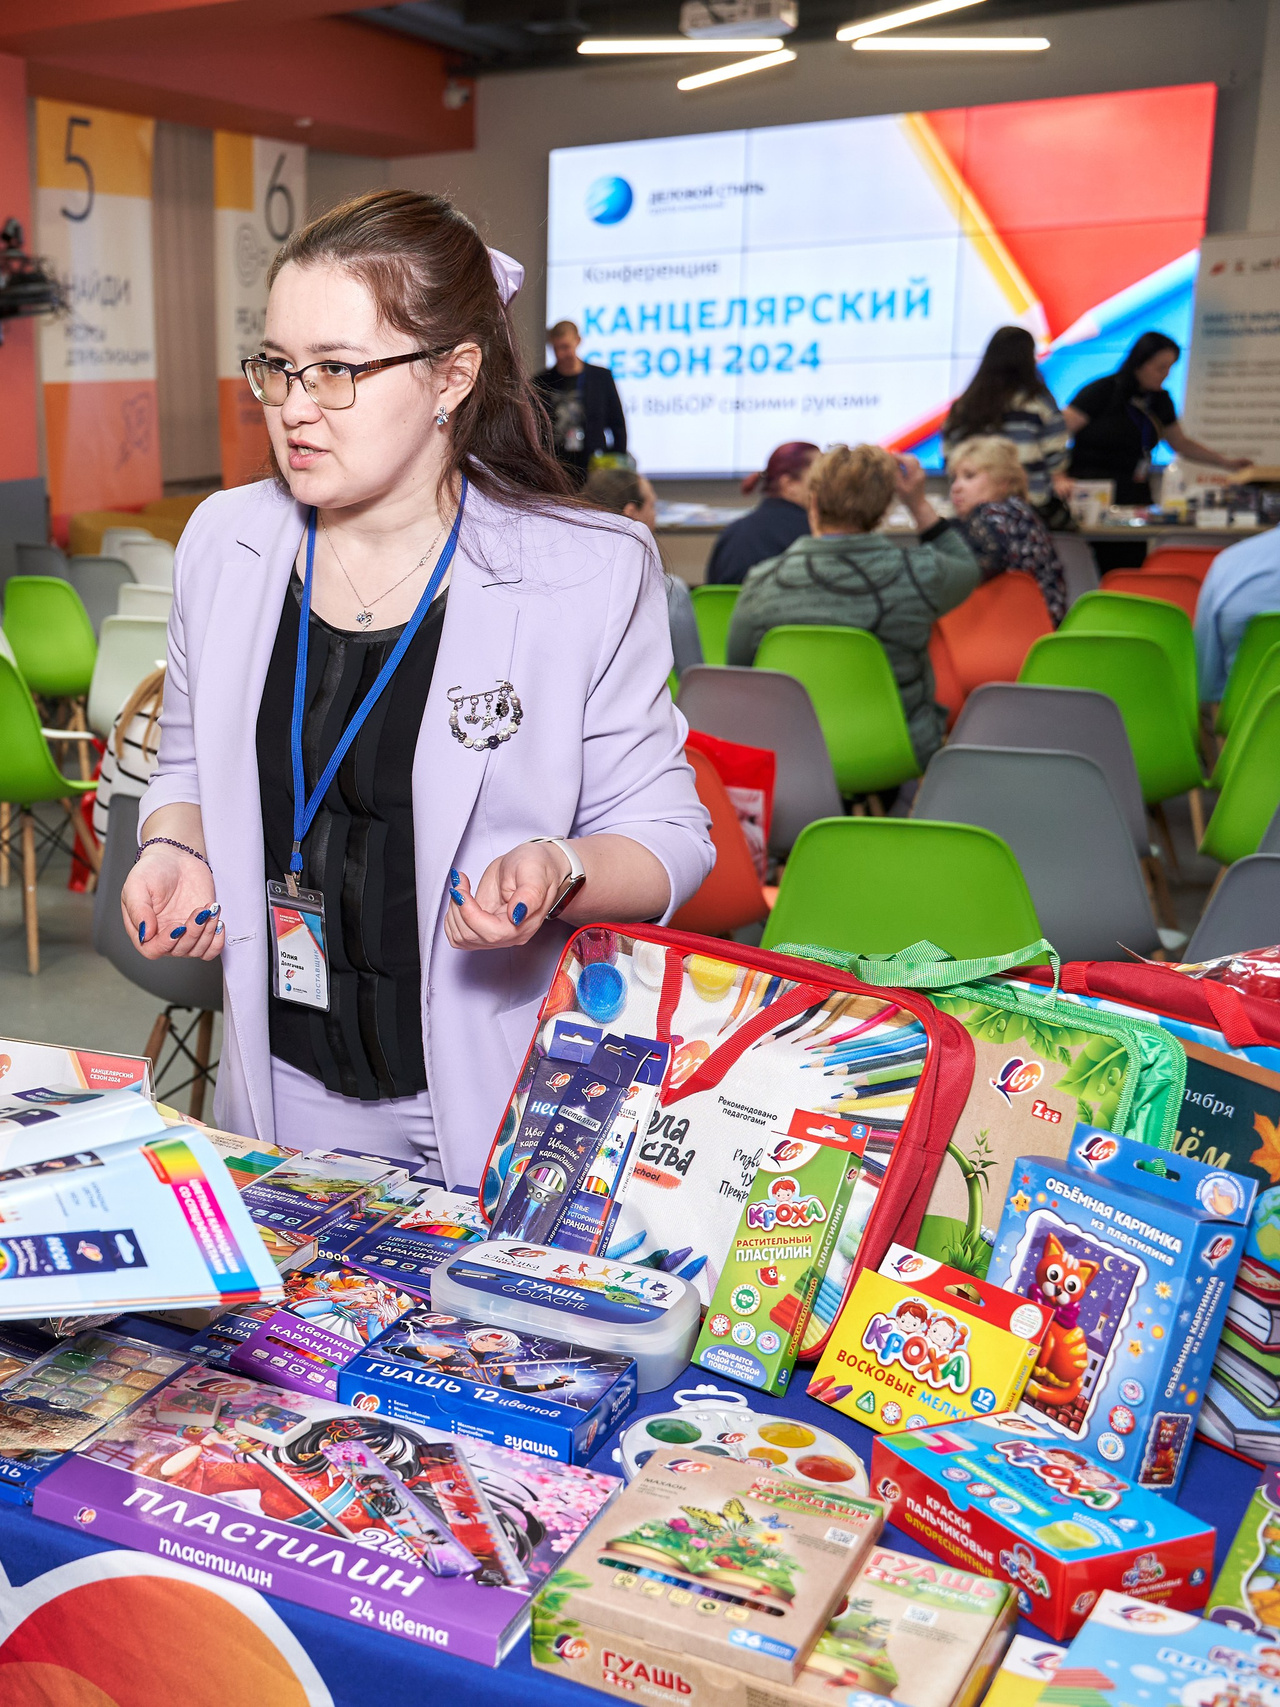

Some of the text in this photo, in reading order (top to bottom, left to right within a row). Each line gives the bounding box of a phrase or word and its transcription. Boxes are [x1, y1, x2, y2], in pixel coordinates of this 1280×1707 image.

[60, 115, 95, 223] 5
[264, 151, 295, 242] 6
[583, 275, 933, 338] КАНЦЕЛЯРСКИЙ
[584, 340, 822, 381] СЕЗОН 2024
[280, 950, 298, 962] Юлия
[312, 948, 322, 1000] ПОСТАВЩИК
[89, 1073, 121, 1084] СЕЗОН 2024
[90, 1067, 134, 1080] КАНЦЕЛЯРСКИЙ
[559, 1106, 601, 1131] металлик
[717, 1095, 779, 1122] Рекомендовано
[722, 1106, 767, 1128] педагогами
[648, 1108, 691, 1146] ола
[855, 1124, 864, 1134] 5
[520, 1139, 539, 1150] кара
[547, 1136, 580, 1161] Цветные
[538, 1149, 577, 1174] карандаши
[639, 1141, 696, 1177] ства
[244, 1188, 324, 1212] АКВАРЕЛЬНЫЕ
[251, 1185, 300, 1200] карандаши
[718, 1179, 749, 1204] Прекр
[566, 1210, 606, 1228] УСТОРОННИЕ
[569, 1202, 590, 1213] ЕТНЫЕ
[748, 1198, 824, 1229] КРОХА
[1044, 1176, 1183, 1256] ОБЪЁМНАЯ КАРТИНКА
[562, 1216, 603, 1237] АРАНДАШИ
[817, 1203, 845, 1268] ПЛАСТИЛИН
[375, 1244, 447, 1263] КАРАНДАШ
[387, 1235, 436, 1249] ЦВЕТНЫЕ
[600, 1233, 610, 1257] OUBLE
[736, 1233, 813, 1248] РАСТИТЕЛЬНЫЙ
[1089, 1217, 1175, 1267] из пластилина
[734, 1246, 813, 1263] ПЛАСТИЛИН
[501, 1284, 590, 1311] GOUACHE
[516, 1279, 586, 1301] ГУАШЬ
[787, 1277, 819, 1357] РАСТИТЕЛЬНЫЙ
[1197, 1280, 1225, 1341] пластилина
[212, 1324, 251, 1339] КАРА
[1164, 1276, 1219, 1400] ОБЪЁМНАЯ КАРТИНКА
[282, 1350, 328, 1374] 12 цветов
[706, 1351, 730, 1365] ВОДОЙ
[734, 1362, 760, 1377] ЛЮБОЙ
[717, 1348, 753, 1366] СМЫВАЕТСЯ
[864, 1316, 966, 1390] КРОХА
[708, 1360, 754, 1382] ПОВЕРХНОСТИ!
[836, 1348, 917, 1399] ВОСКОВЫЕ
[366, 1361, 561, 1418] ГУАШЬ 12 цветов
[977, 1388, 993, 1407] 12
[503, 1434, 560, 1458] гуашь
[644, 1477, 688, 1491] МАХАОН
[998, 1441, 1114, 1507] КРОХА
[750, 1482, 872, 1523] КАРАНДАШИ
[925, 1494, 972, 1534] КРАСКИ
[122, 1486, 425, 1598] ПЛАСТИЛИН
[905, 1496, 994, 1565] ПАЛЬЧИКОВЫЕ
[904, 1510, 994, 1579] ФЛУОРЕСЦЕНТНЫЕ
[158, 1536, 273, 1589] пластилин
[869, 1551, 998, 1599] ГУАШЬ
[349, 1595, 450, 1647] 24 цвета
[730, 1629, 762, 1649] 36
[602, 1649, 692, 1695] ГУАШЬ
